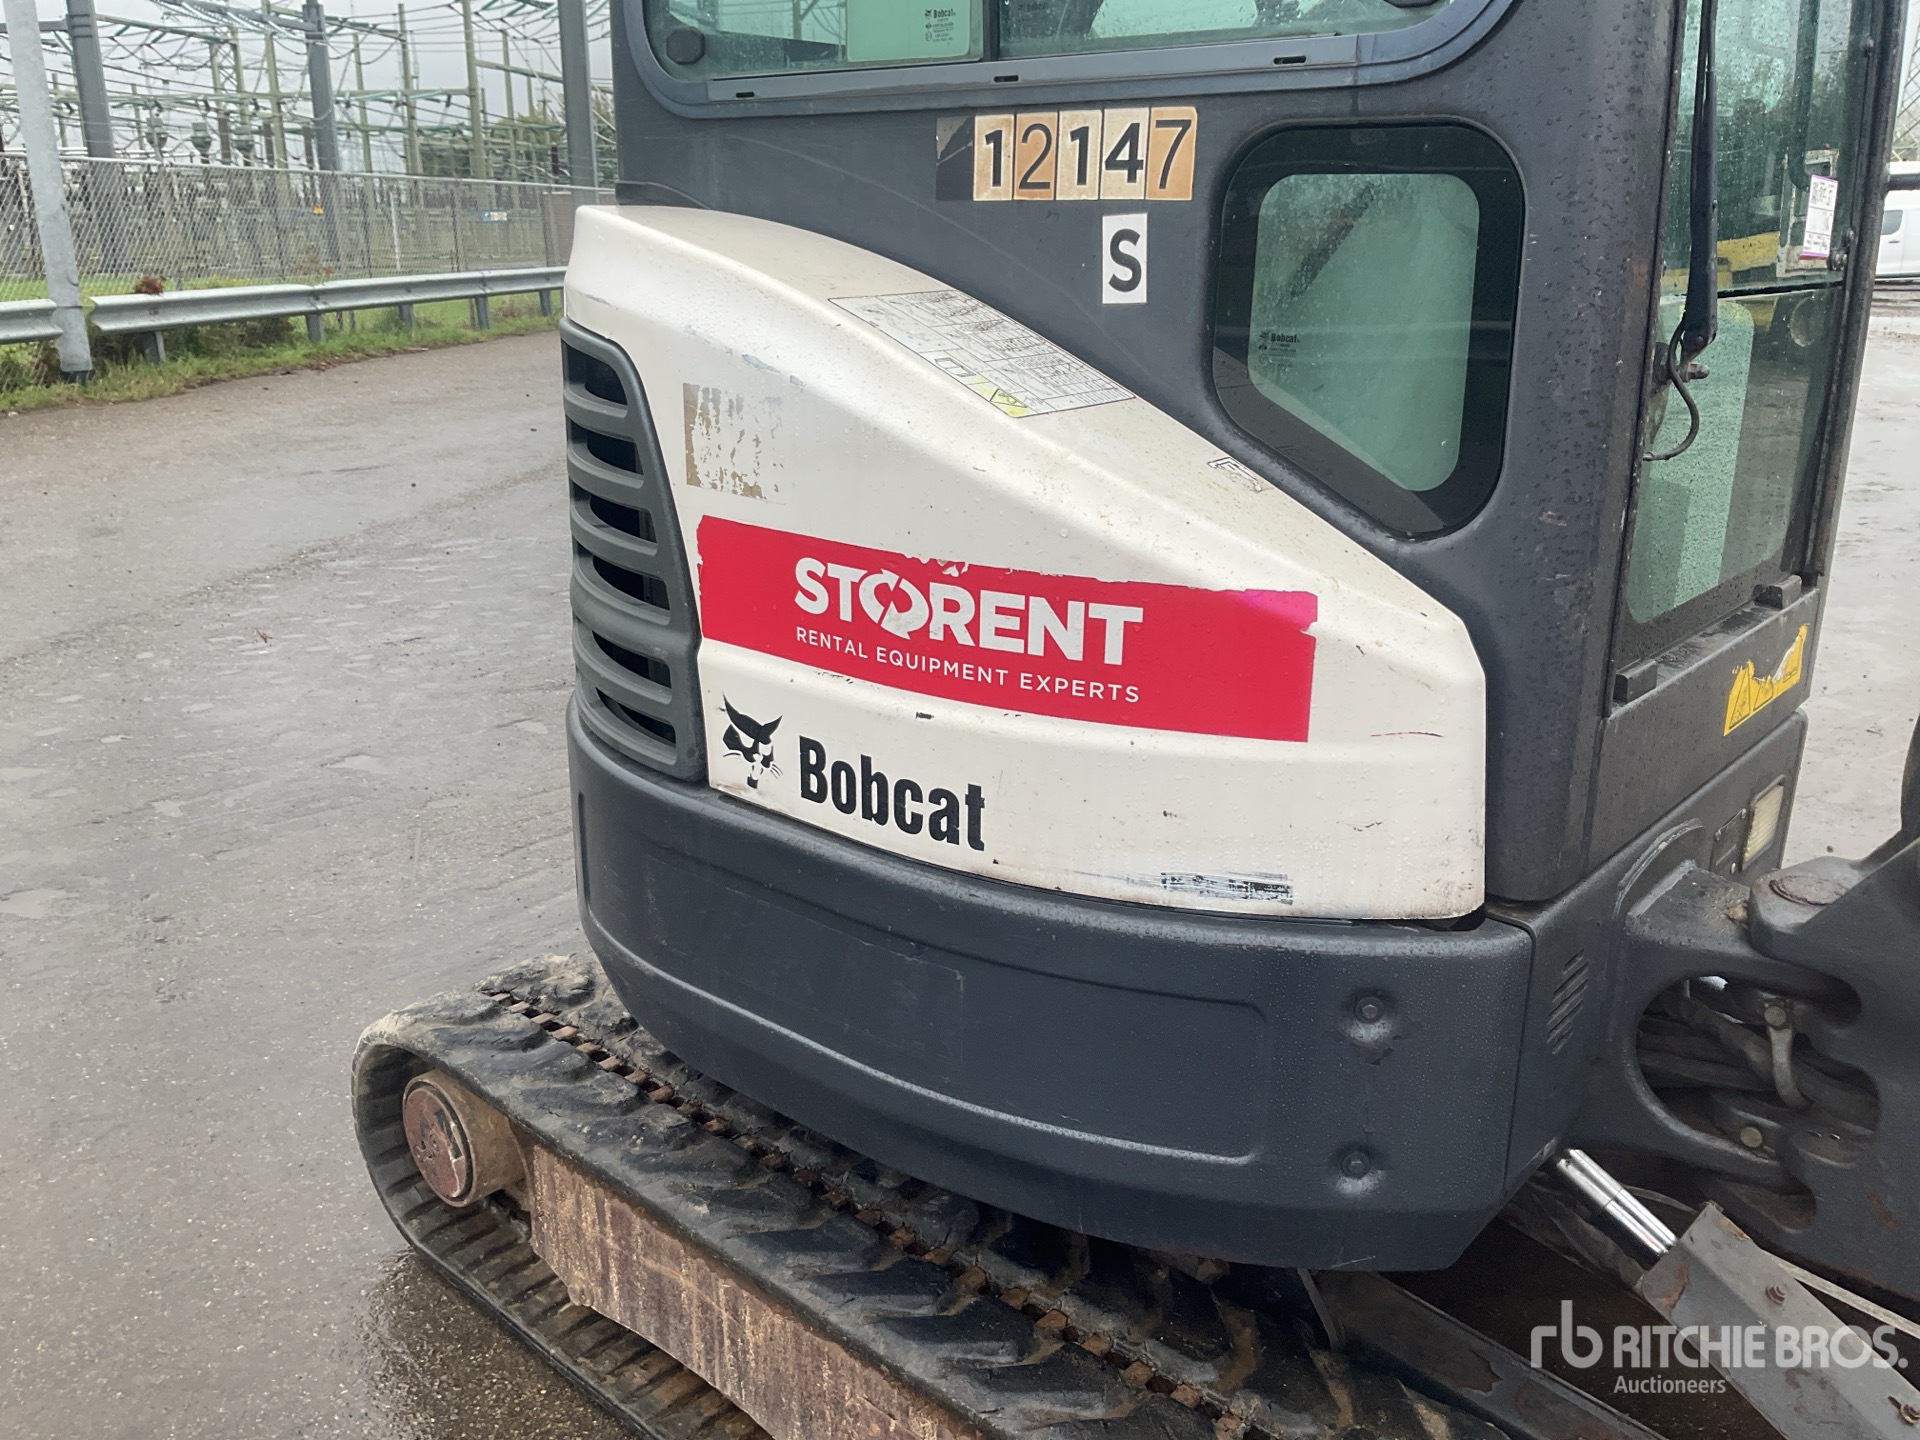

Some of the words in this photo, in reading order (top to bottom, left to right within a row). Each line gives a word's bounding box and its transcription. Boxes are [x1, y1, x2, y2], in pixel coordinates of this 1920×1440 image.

[933, 8, 954, 18] Bobcat
[984, 119, 1192, 190] 12147
[1108, 228, 1142, 292] S
[1270, 333, 1298, 343] Bobcat
[794, 557, 1144, 666] STORENT
[796, 626, 869, 659] RENTAL
[876, 647, 1009, 686] EQUIPMENT
[1019, 673, 1140, 703] EXPERTS
[799, 734, 986, 852] Bobcat
